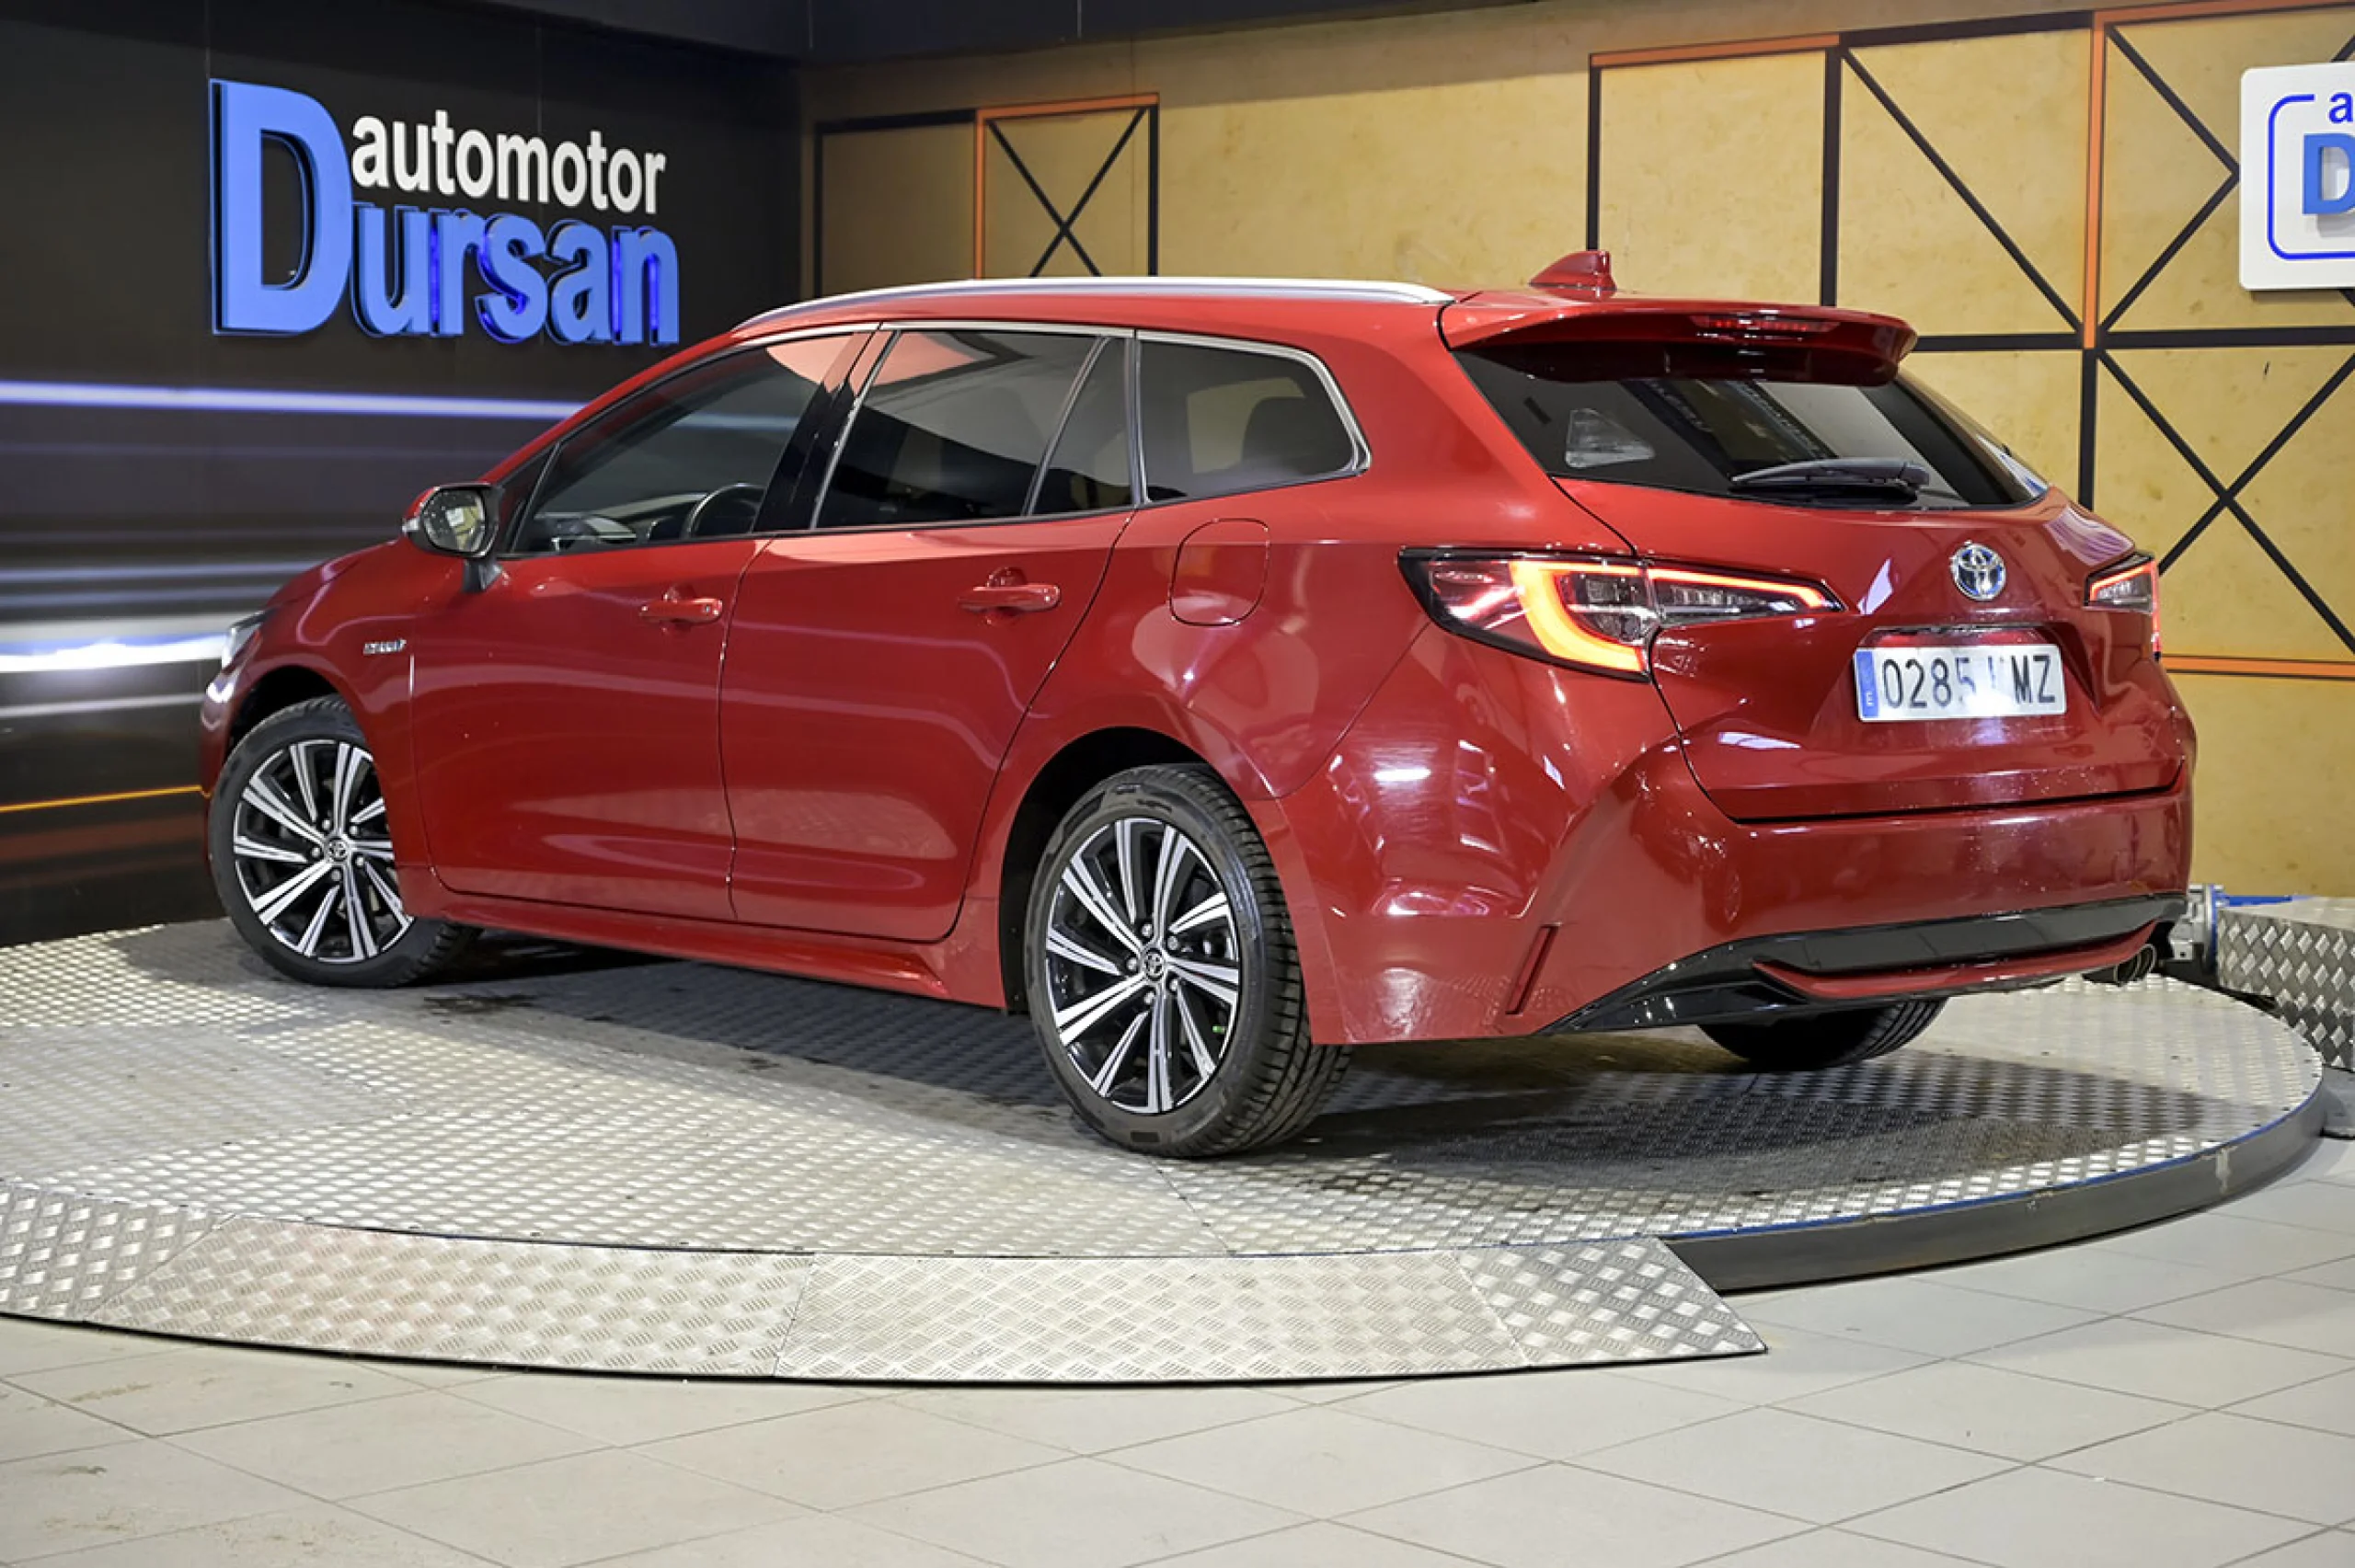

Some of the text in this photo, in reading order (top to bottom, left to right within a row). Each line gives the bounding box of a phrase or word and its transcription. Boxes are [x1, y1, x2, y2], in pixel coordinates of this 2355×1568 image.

[209, 78, 680, 347] Dursan
[350, 109, 667, 214] automotor
[1882, 656, 1977, 709] 0285
